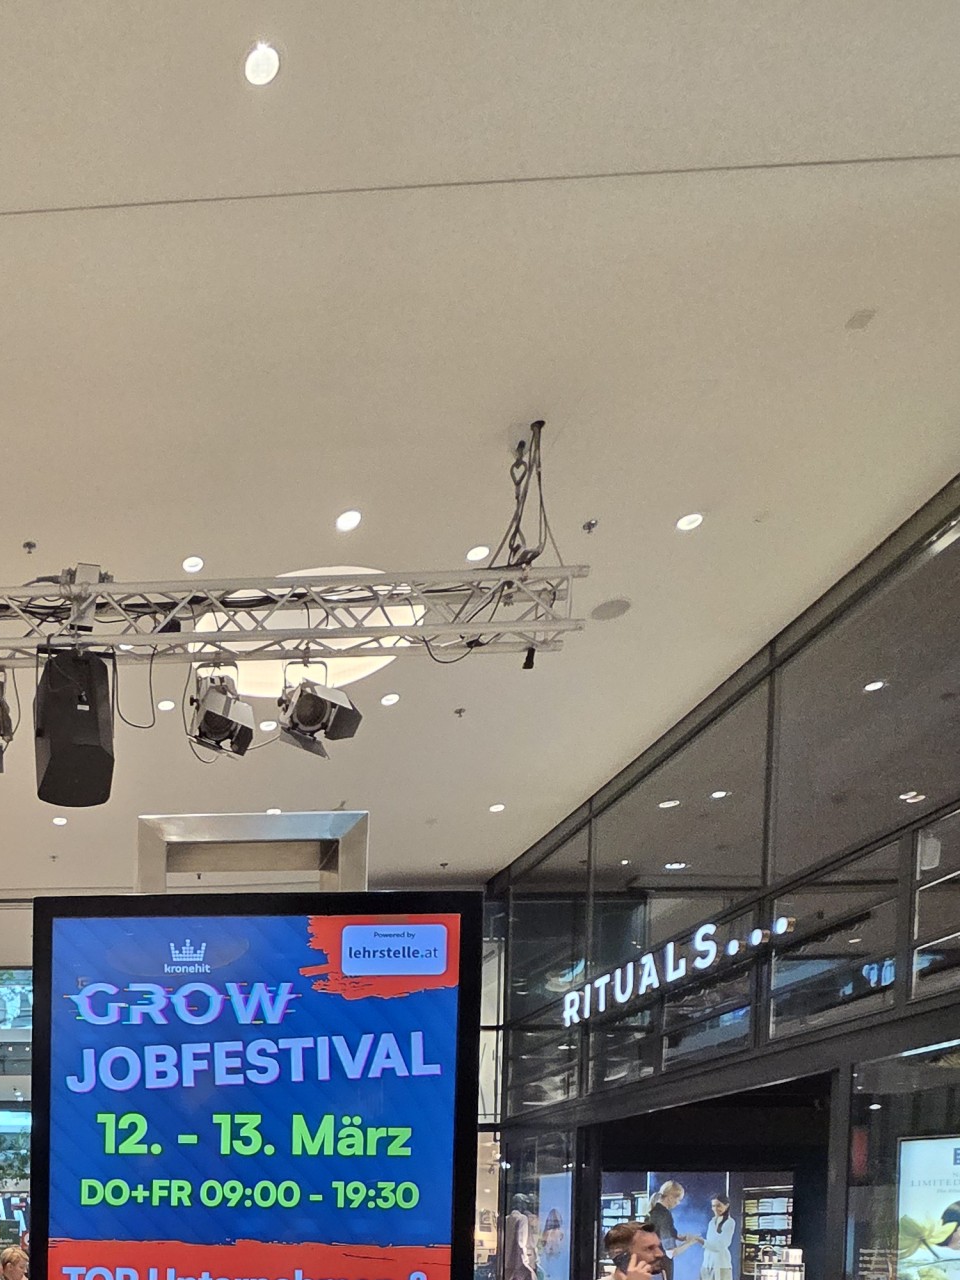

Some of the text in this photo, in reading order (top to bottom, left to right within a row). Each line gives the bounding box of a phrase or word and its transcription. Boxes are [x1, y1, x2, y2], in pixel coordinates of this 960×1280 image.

[373, 930, 416, 940] Powered by
[348, 945, 439, 960] lehrstelle.at
[164, 962, 211, 974] kronehit
[66, 982, 301, 1025] GROW
[65, 1031, 441, 1093] JOBFESTIVAL
[96, 1113, 162, 1155] 12.
[212, 1114, 275, 1156] 13.
[292, 1115, 412, 1157] März
[80, 1179, 192, 1206] DO+FR
[200, 1180, 300, 1208] 09:00
[332, 1181, 420, 1209] 19:30
